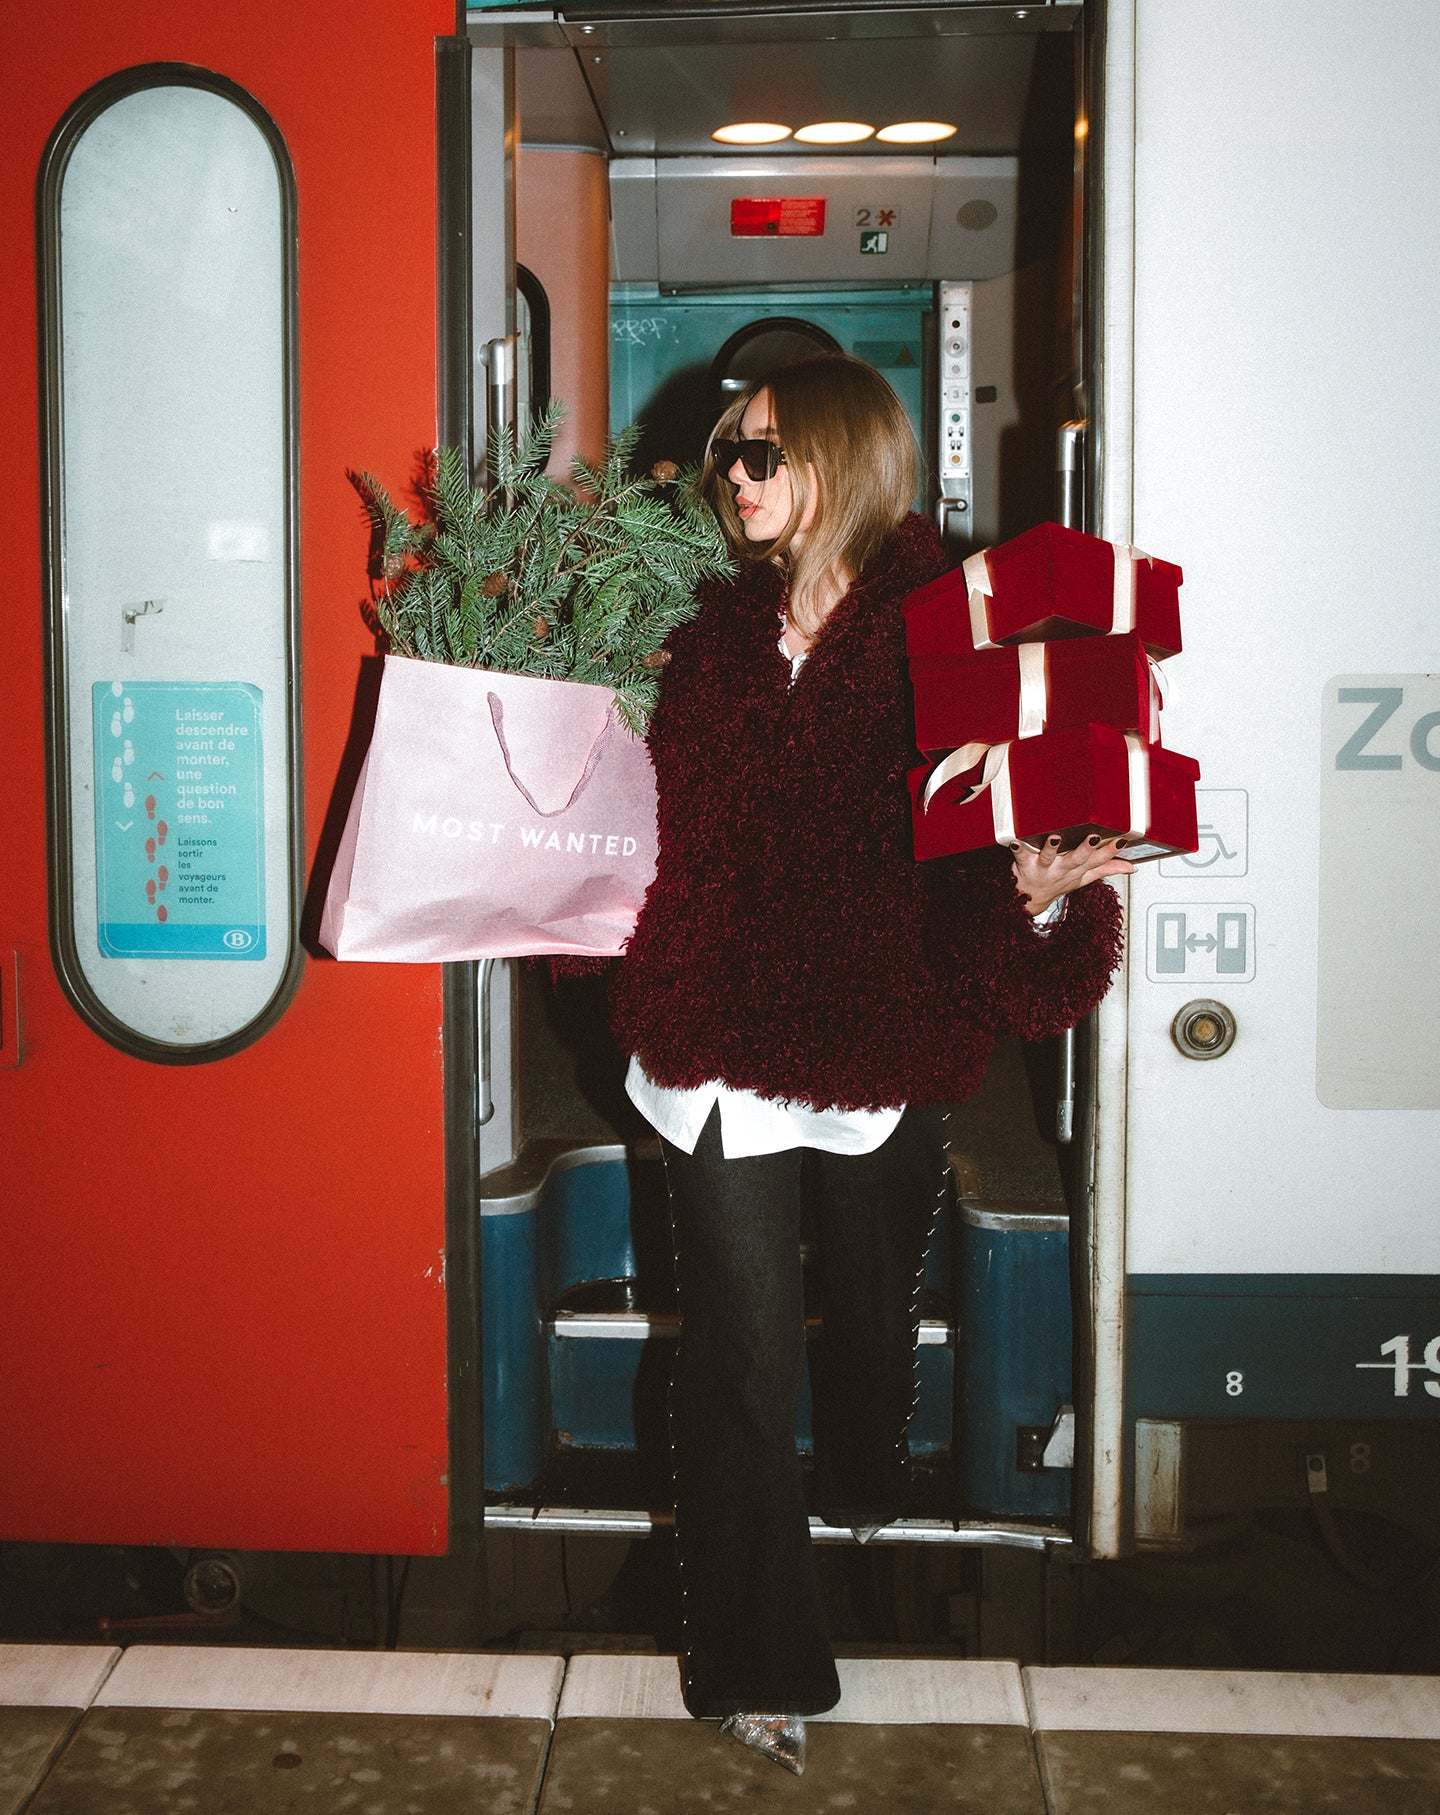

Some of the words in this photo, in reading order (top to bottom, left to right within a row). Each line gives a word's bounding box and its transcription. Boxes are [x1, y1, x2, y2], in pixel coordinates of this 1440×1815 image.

[855, 208, 871, 227] 2
[176, 708, 224, 721] Laisser
[176, 723, 248, 736] descendre
[176, 739, 214, 750] avant
[218, 738, 235, 750] de
[177, 755, 230, 767] monter,
[177, 770, 202, 780] une
[177, 782, 237, 800] question
[177, 797, 194, 809] de
[198, 798, 224, 809] bon
[177, 814, 212, 824] sens.
[411, 812, 506, 845] MOST
[520, 826, 638, 857] WANTED
[178, 837, 217, 847] Laissons
[178, 849, 203, 858] sortir
[178, 861, 191, 869] les
[178, 873, 226, 883] voyageurs
[178, 884, 204, 892] avant
[206, 884, 219, 893] de
[178, 896, 215, 904] monter.
[1226, 1371, 1243, 1396] 8
